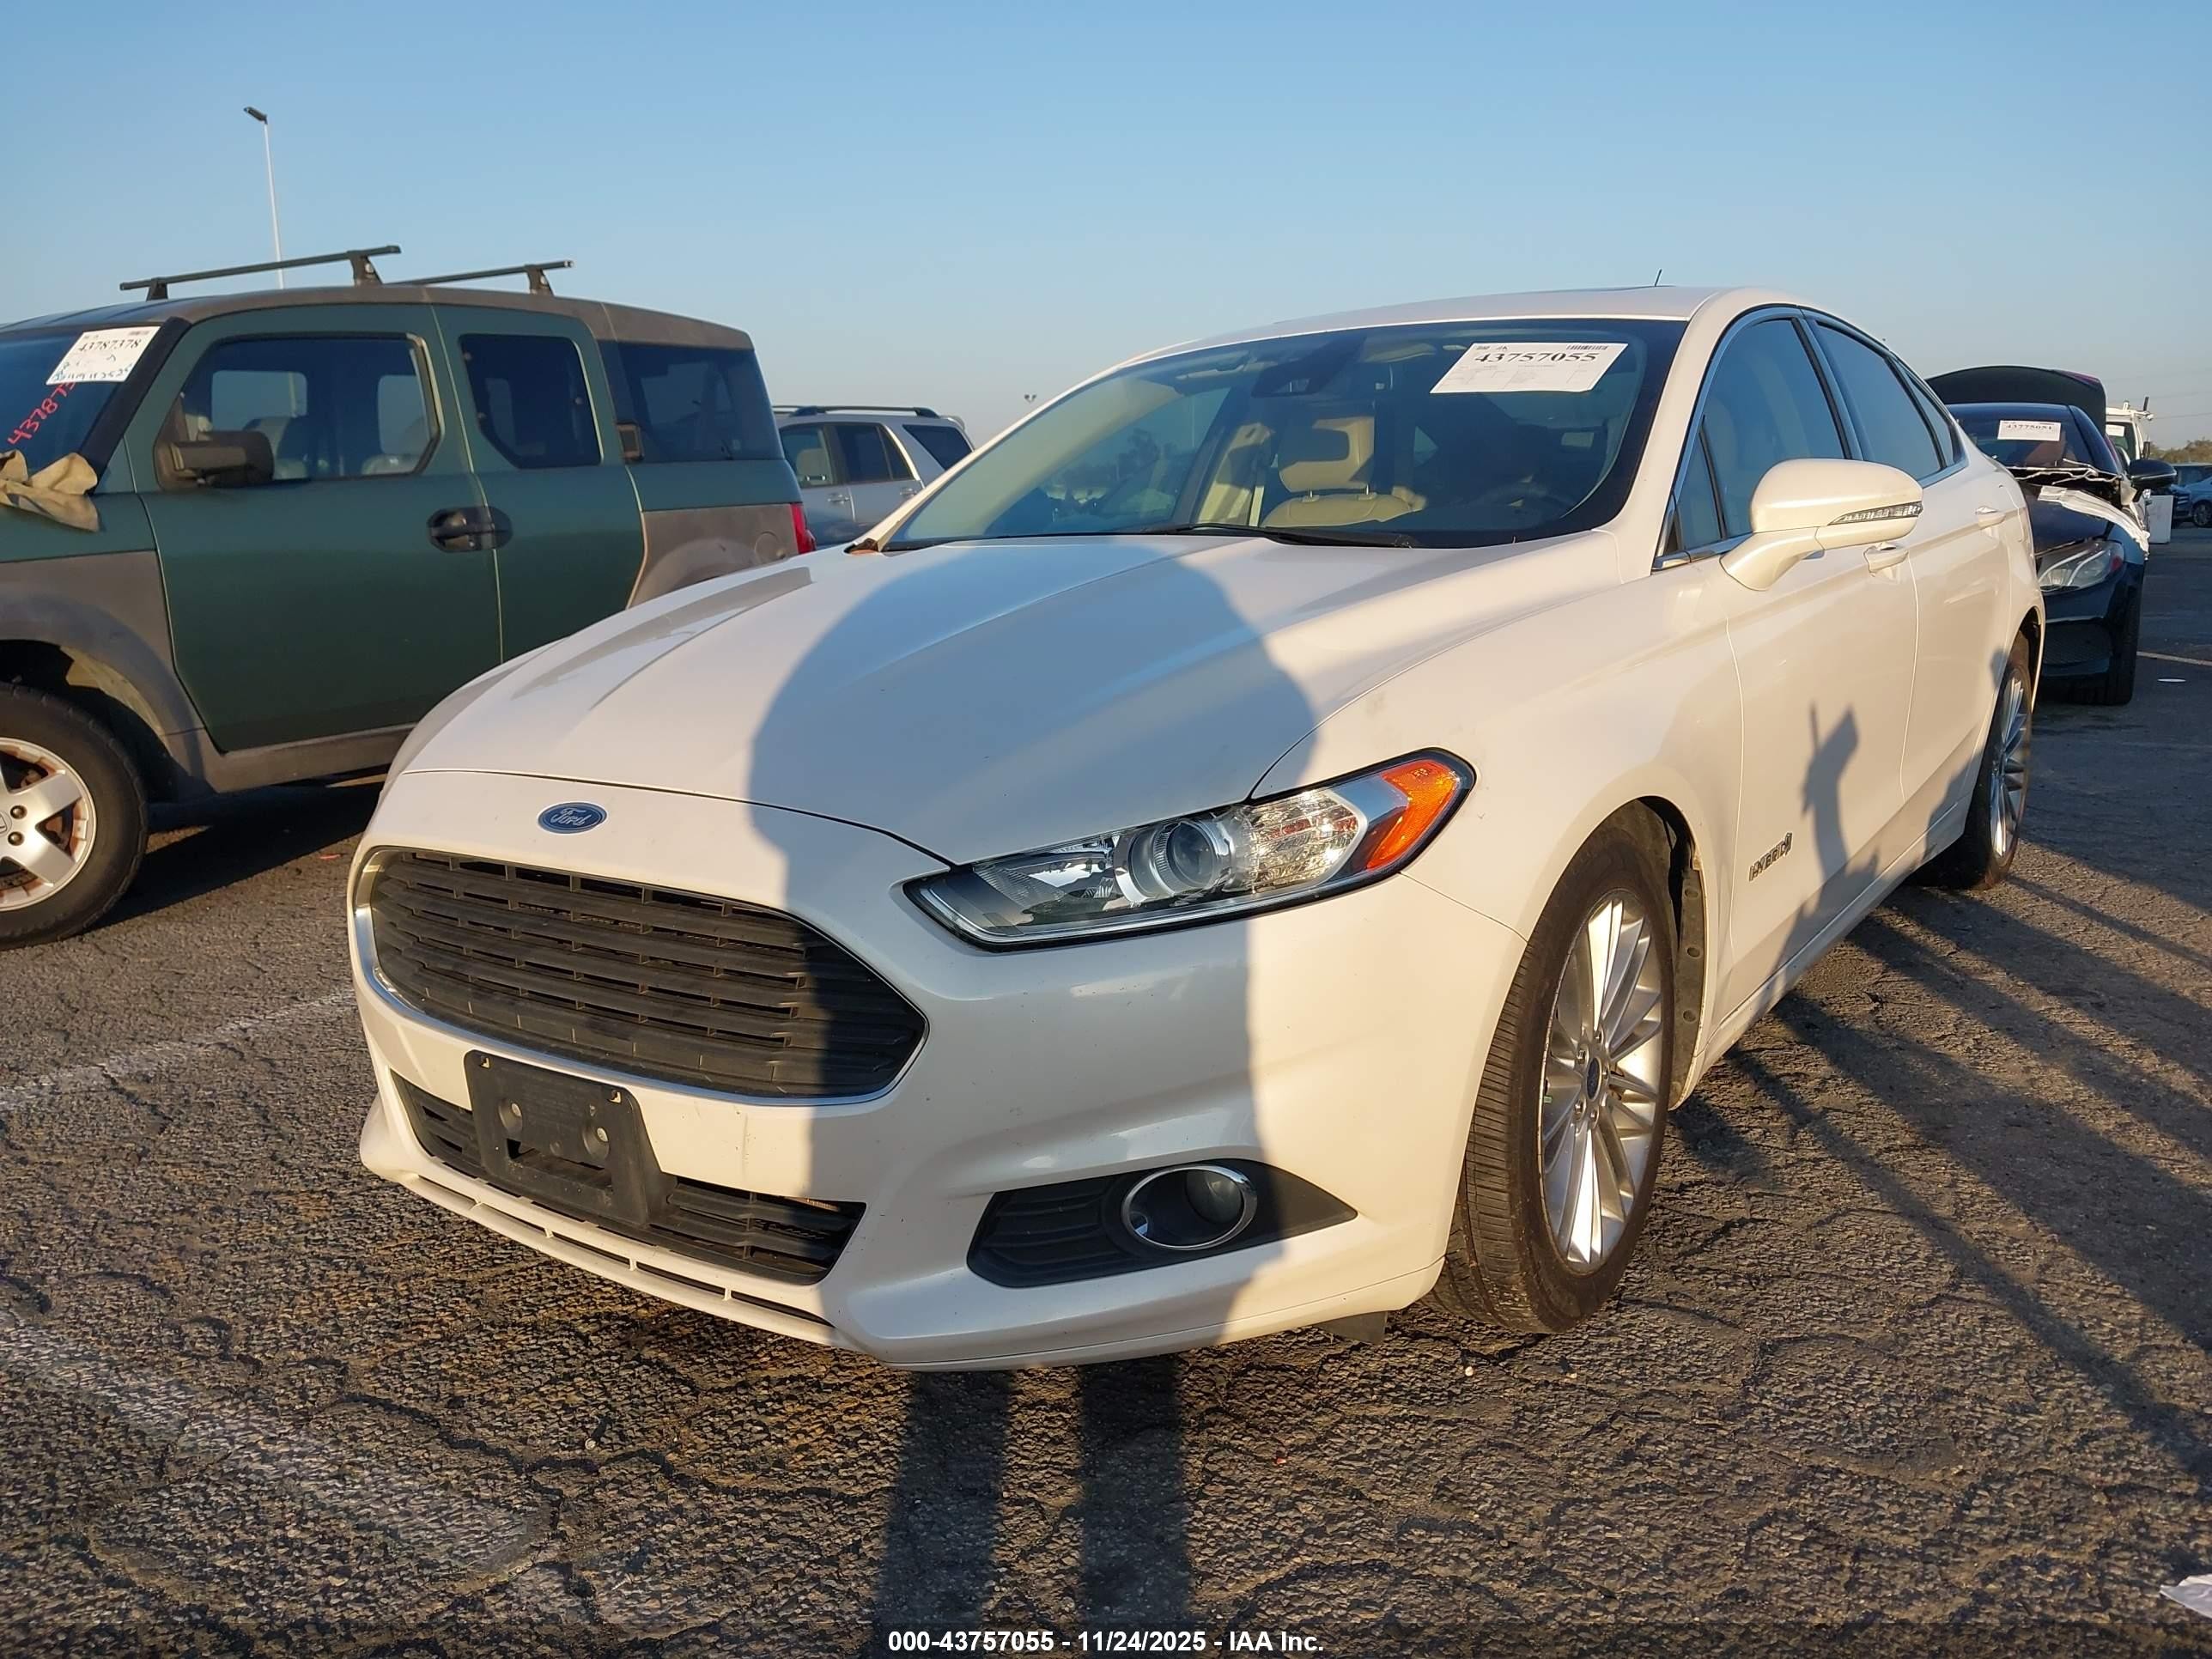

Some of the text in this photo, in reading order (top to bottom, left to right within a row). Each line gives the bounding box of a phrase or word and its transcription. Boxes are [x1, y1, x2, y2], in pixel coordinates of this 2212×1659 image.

[78, 338, 142, 352] 43787378
[1474, 352, 1601, 362] 43757055
[550, 806, 592, 826] Ford
